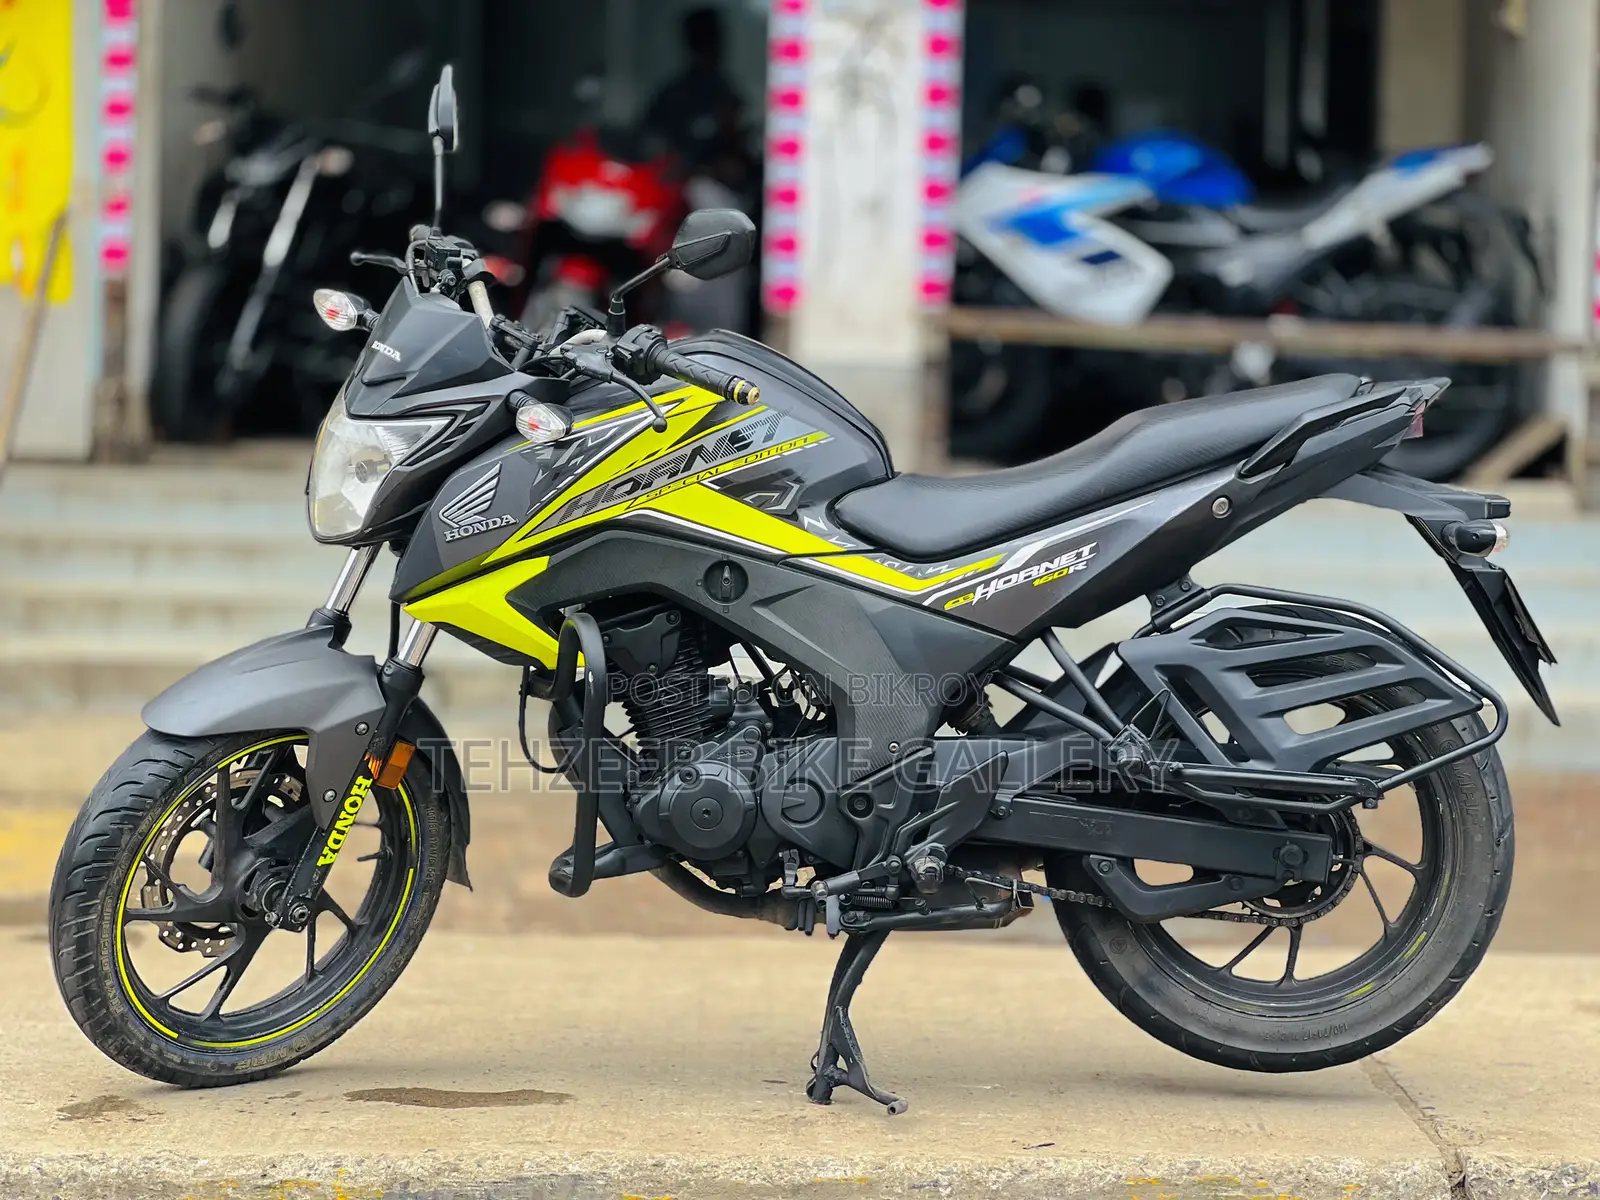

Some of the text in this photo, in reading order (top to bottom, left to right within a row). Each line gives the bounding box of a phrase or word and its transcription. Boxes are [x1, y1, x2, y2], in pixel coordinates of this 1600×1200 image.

[557, 406, 794, 525] HORNET
[645, 437, 809, 499] SPECIAL EDITION
[444, 514, 516, 541] HONDA
[943, 541, 1098, 610] CB HORNET
[1032, 560, 1087, 587] 160R
[317, 775, 373, 867] HONDA
